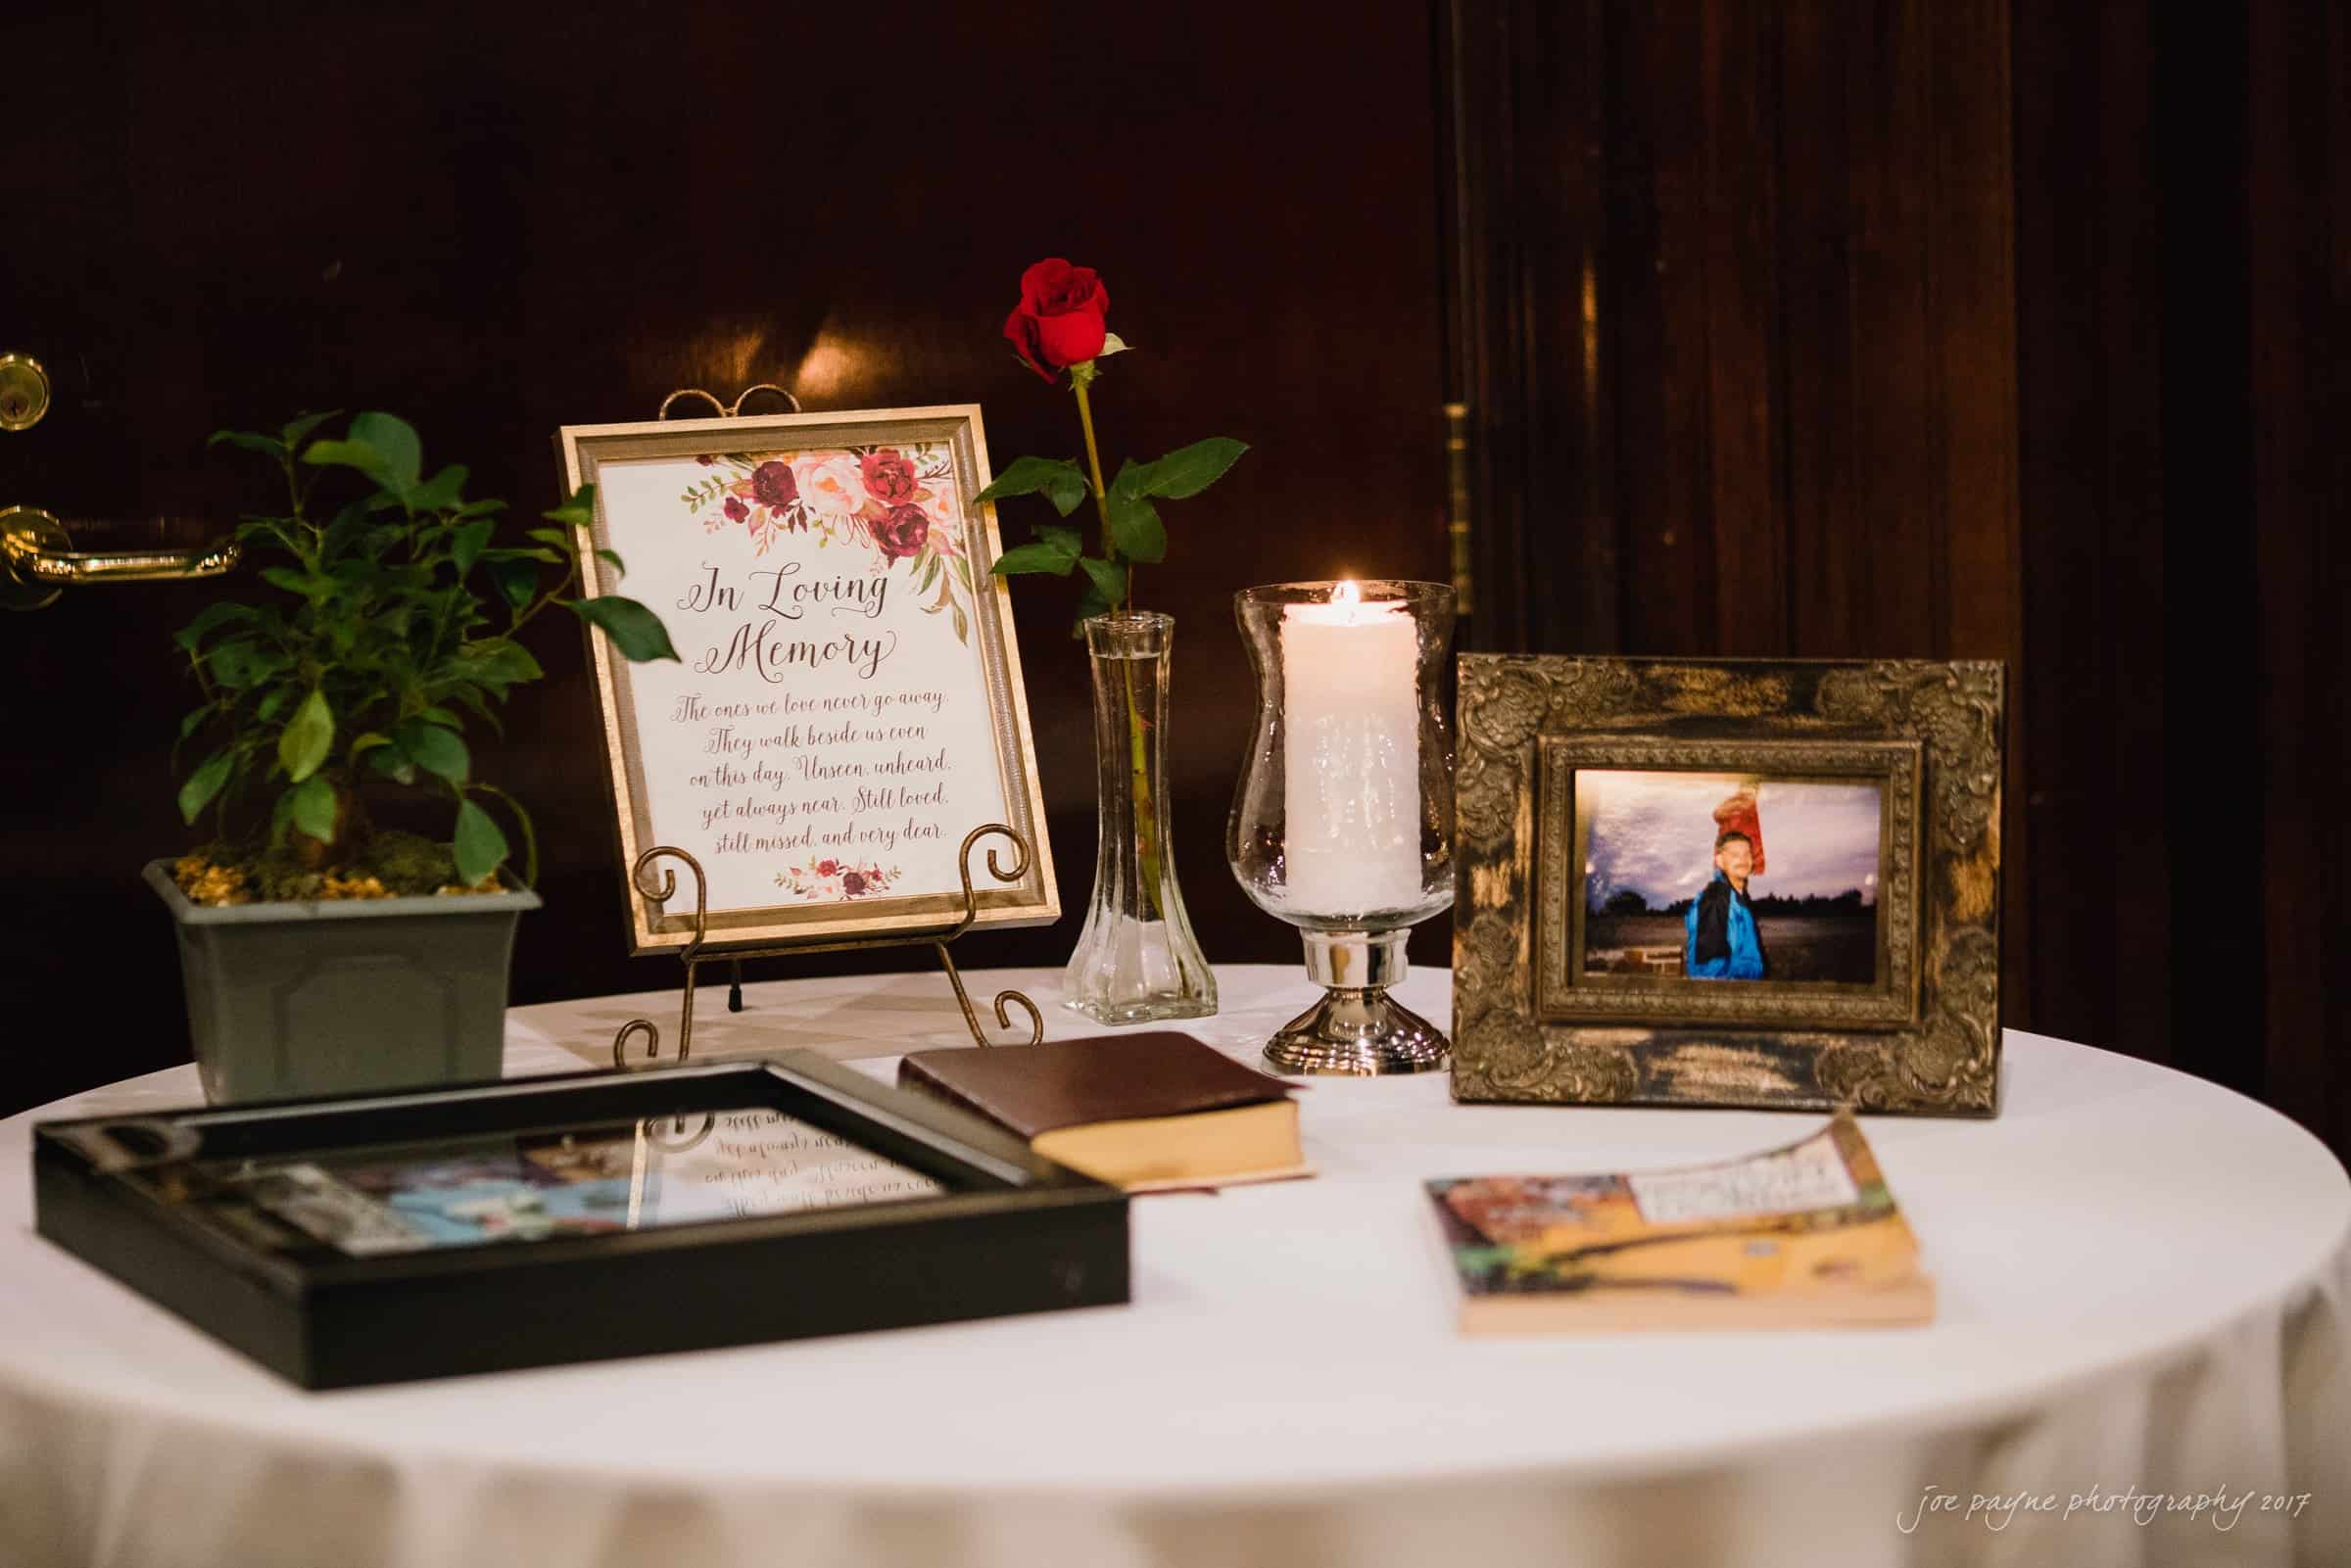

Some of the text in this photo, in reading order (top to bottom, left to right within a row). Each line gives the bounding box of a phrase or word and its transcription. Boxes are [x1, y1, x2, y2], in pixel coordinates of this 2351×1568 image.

[676, 561, 888, 620] In Loving
[694, 619, 897, 684] Memory
[671, 691, 707, 723] The
[714, 703, 749, 718] ones
[755, 701, 776, 715] we
[784, 692, 816, 714] love
[823, 693, 868, 712] never
[874, 694, 892, 718] go
[703, 721, 926, 760] They walk beside us even
[690, 773, 710, 787] on
[714, 762, 745, 785] this
[702, 799, 730, 830] yet
[736, 796, 794, 825] always
[851, 784, 895, 815] Still
[715, 832, 750, 854] still
[822, 822, 853, 846] and
[859, 826, 894, 851] very
